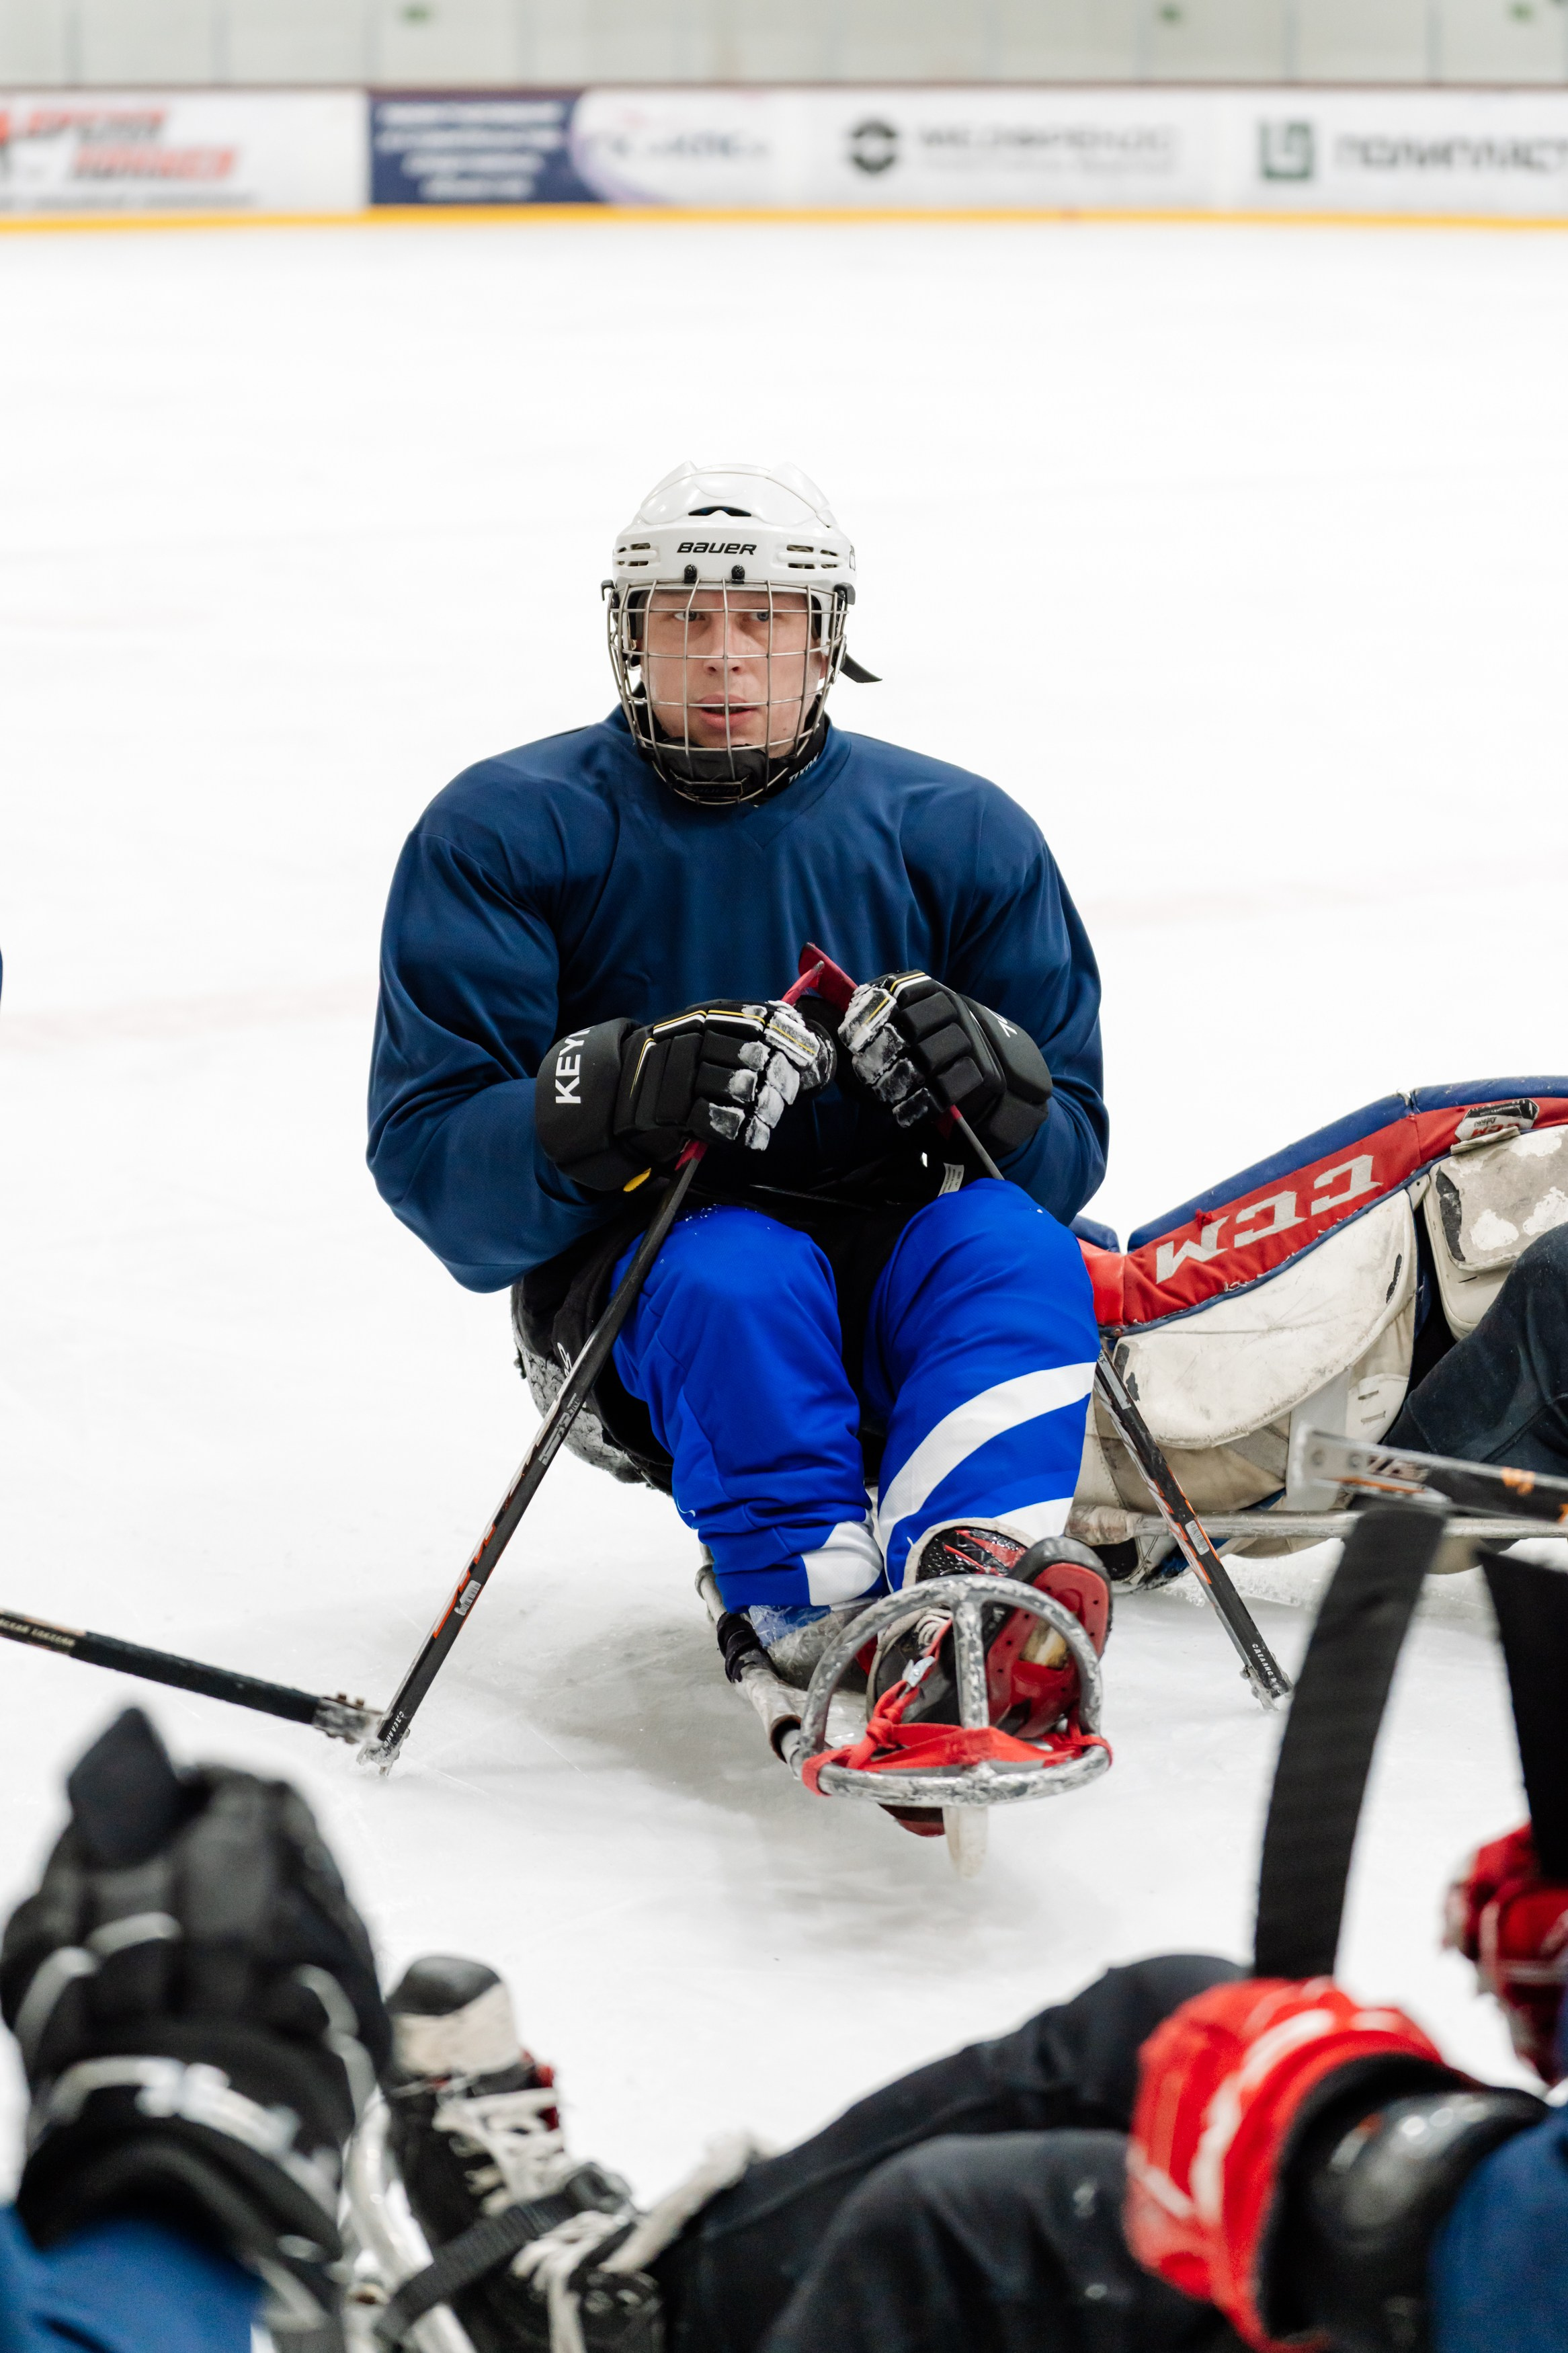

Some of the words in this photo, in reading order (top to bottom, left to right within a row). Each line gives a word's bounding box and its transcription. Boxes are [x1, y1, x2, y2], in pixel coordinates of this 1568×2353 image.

[676, 542, 757, 555] BAUER
[555, 1026, 595, 1104] KEY
[1156, 1154, 1383, 1285] CCM
